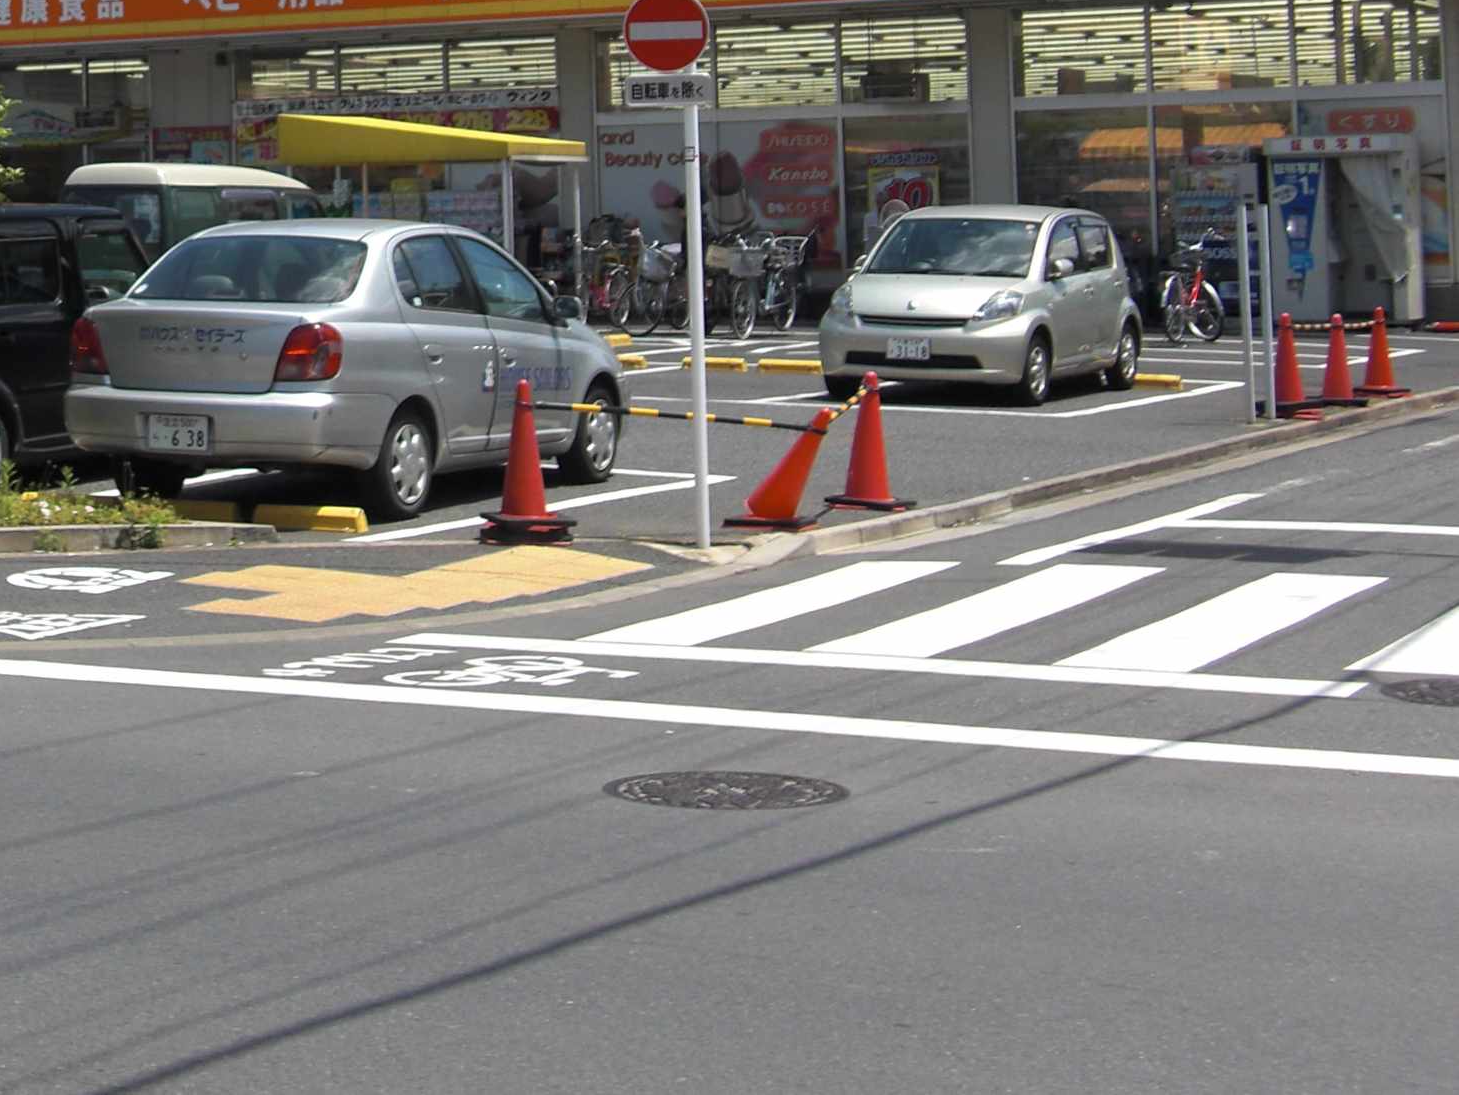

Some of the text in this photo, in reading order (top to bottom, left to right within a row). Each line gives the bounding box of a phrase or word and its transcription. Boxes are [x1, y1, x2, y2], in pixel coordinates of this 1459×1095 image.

[632, 81, 704, 100] 自転車を除く
[601, 130, 634, 145] and
[605, 151, 663, 169] Beauty
[768, 166, 828, 181] Kanebo
